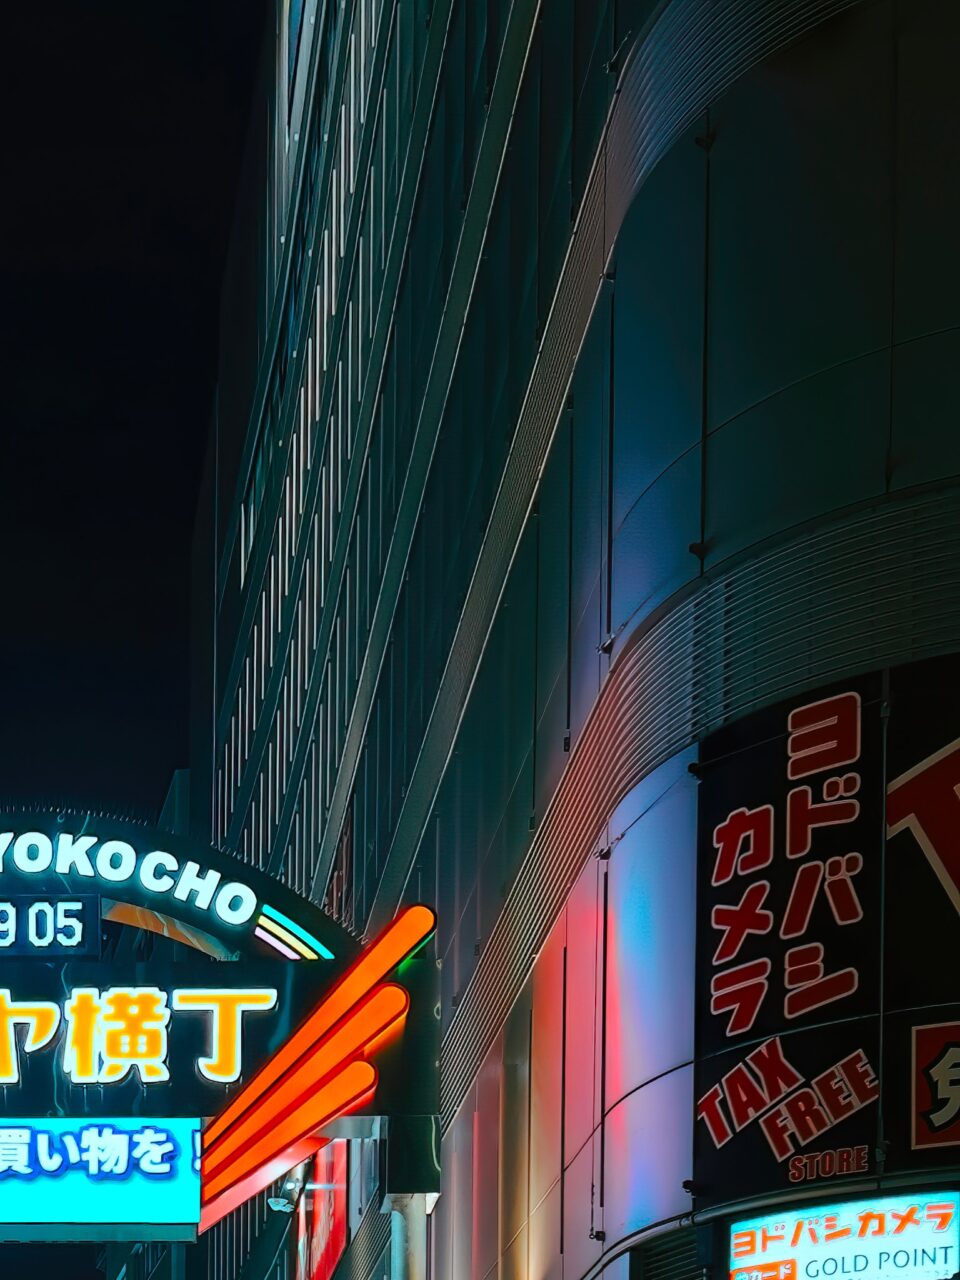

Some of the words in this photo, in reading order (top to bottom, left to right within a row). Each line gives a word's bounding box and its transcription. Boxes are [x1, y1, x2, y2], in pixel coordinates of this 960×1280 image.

[779, 691, 863, 1020] ヨドバシ
[711, 804, 775, 1038] カメラ
[697, 1036, 806, 1150] TAX
[758, 1048, 880, 1163] FREE
[788, 1145, 869, 1183] STORE
[733, 1203, 955, 1259] ヨドバシカメラ
[805, 1254, 869, 1278] GOLD
[879, 1245, 954, 1270] POINT
